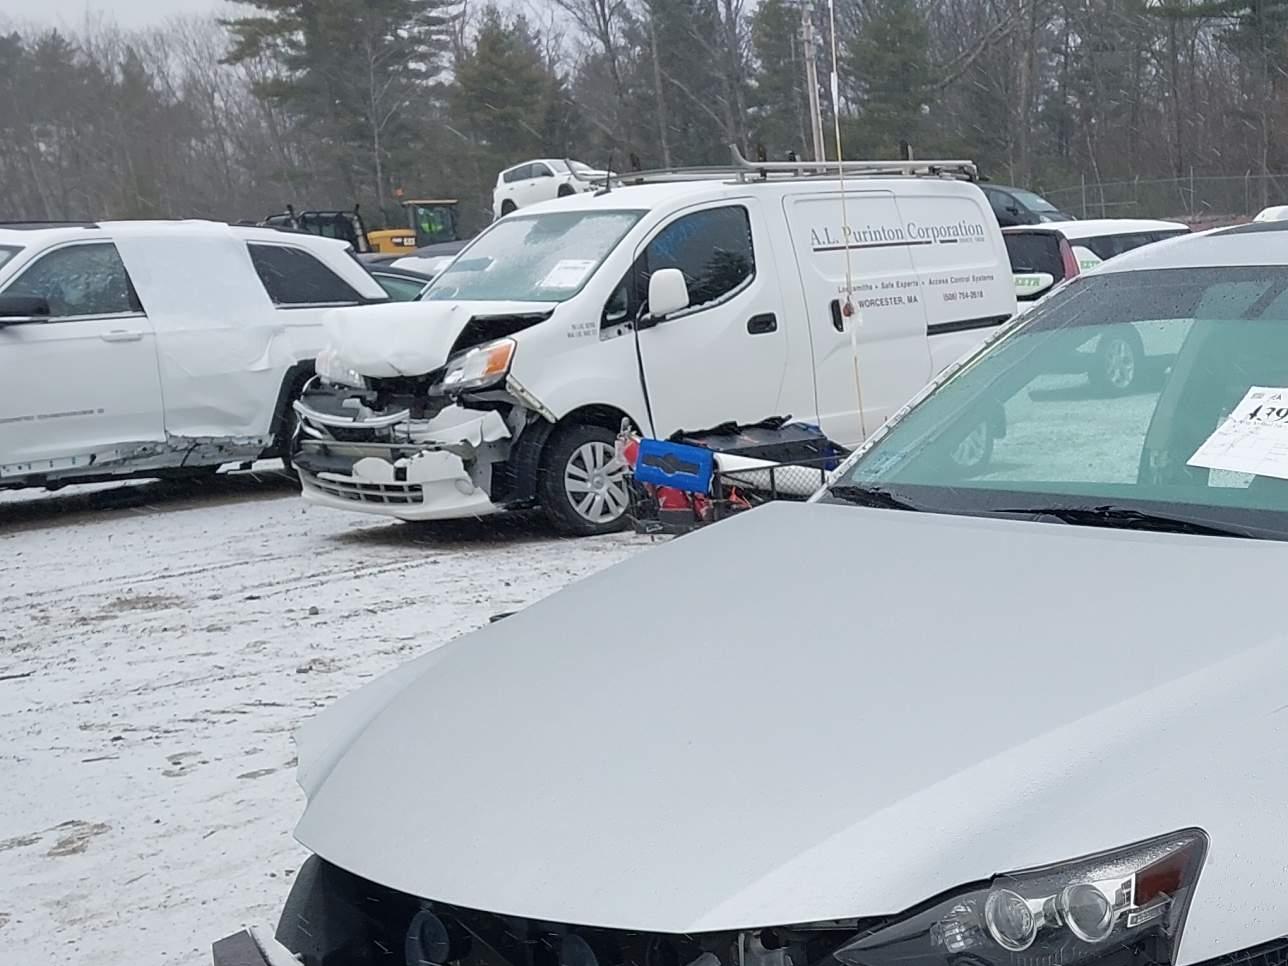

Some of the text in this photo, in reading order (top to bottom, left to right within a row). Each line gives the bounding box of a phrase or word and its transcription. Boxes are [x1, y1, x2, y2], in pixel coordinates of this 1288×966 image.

[811, 220, 984, 246] A.L. Purinton Corporation
[907, 296, 918, 304] MA
